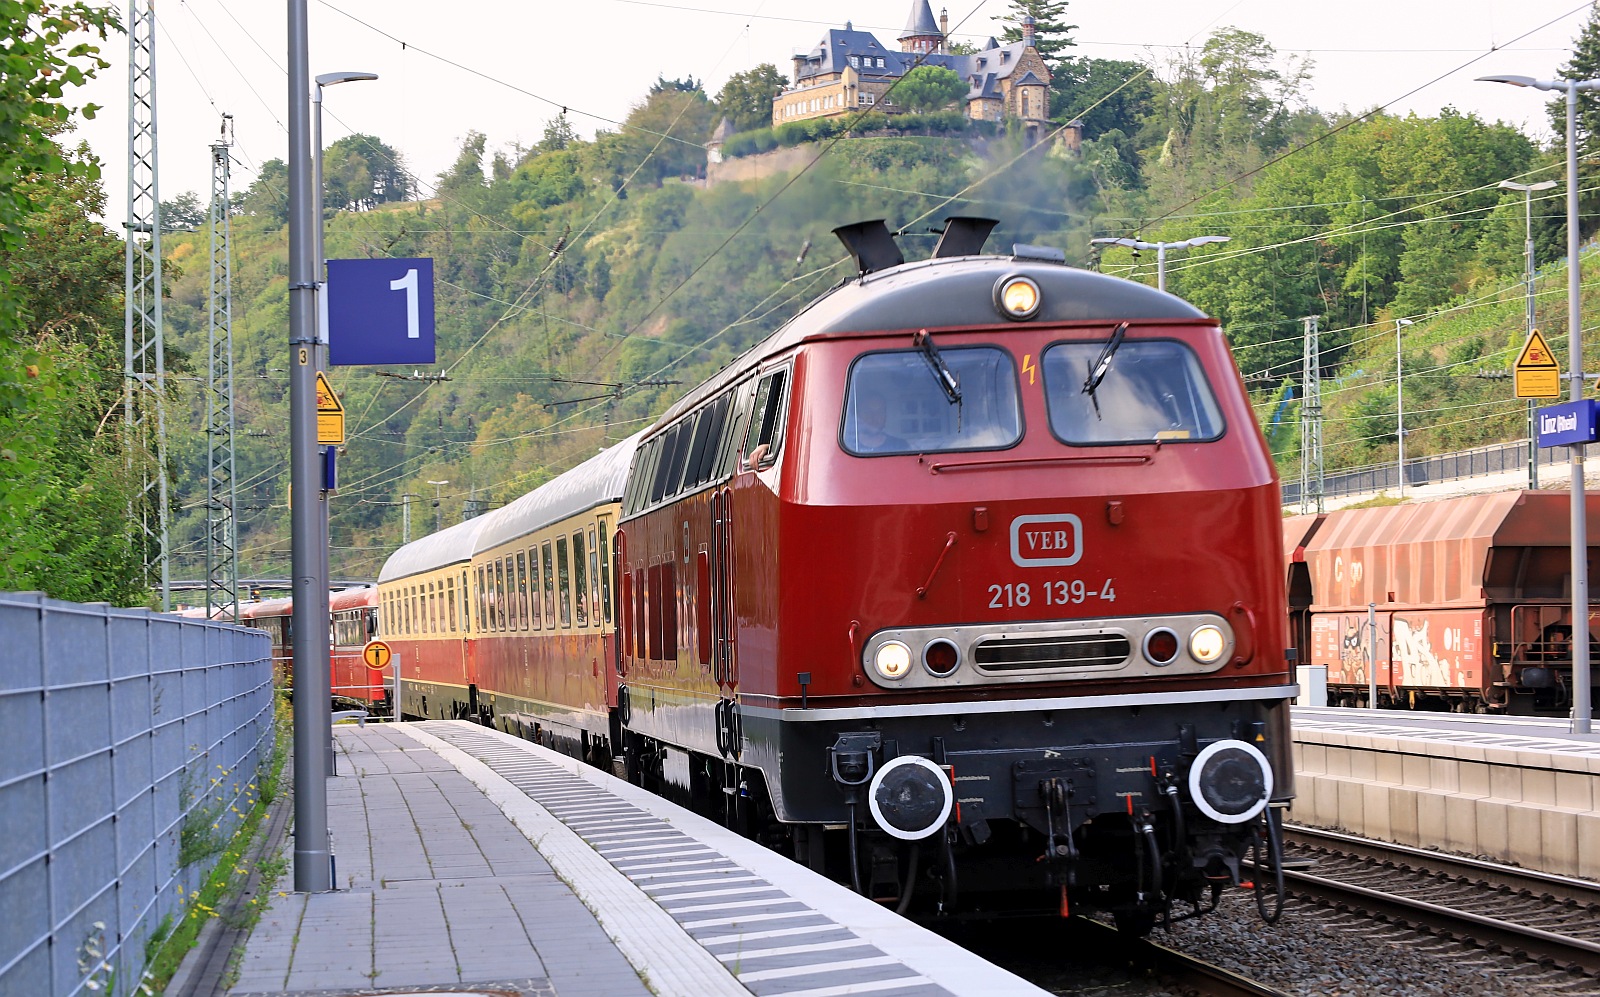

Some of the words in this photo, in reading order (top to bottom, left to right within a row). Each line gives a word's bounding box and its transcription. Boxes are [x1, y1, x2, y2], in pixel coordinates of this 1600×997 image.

[389, 268, 420, 339] 1
[300, 350, 307, 363] 3
[1540, 414, 1557, 435] Linz
[1557, 412, 1577, 434] (Rhein)
[1025, 530, 1068, 550] VEB
[987, 582, 1031, 609] 218
[1043, 578, 1116, 606] 139-4
